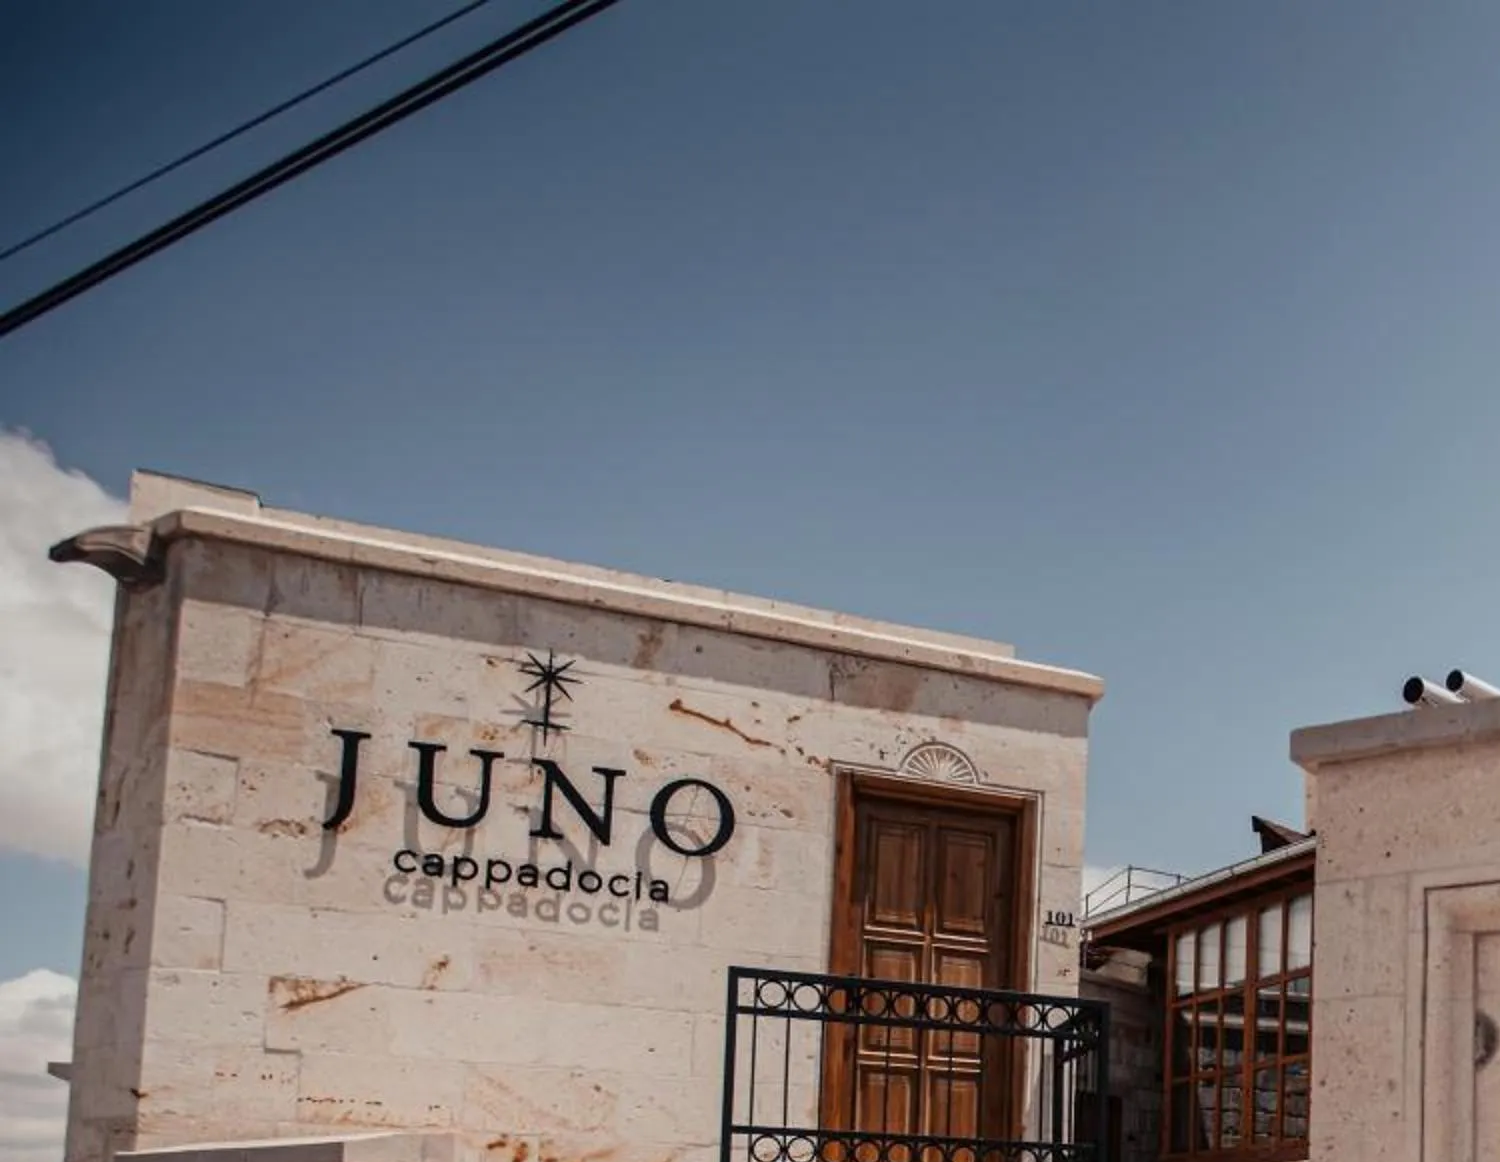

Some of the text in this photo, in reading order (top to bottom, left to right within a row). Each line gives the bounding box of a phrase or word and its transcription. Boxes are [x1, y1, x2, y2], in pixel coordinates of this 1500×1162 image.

[321, 728, 736, 857] JUNO
[392, 848, 671, 904] cappadocia
[1044, 910, 1076, 928] 101
